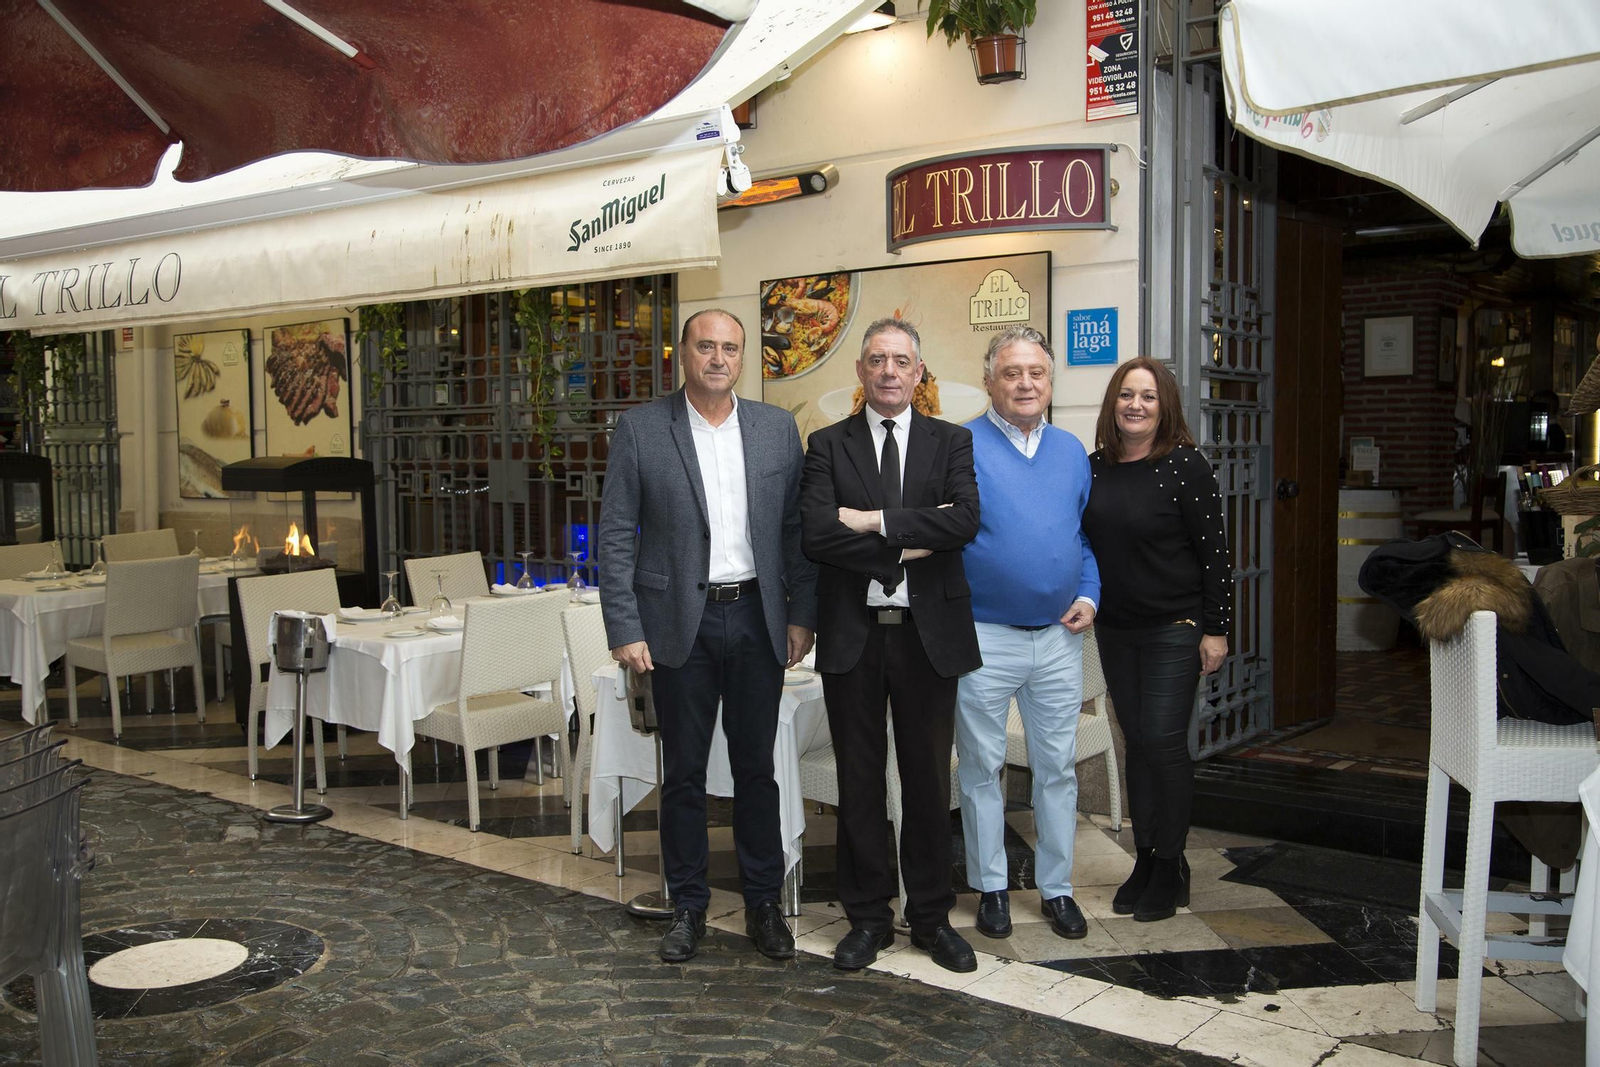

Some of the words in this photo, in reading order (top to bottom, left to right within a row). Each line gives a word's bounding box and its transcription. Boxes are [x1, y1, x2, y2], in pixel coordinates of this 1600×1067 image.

[1092, 14, 1104, 22] 951
[1105, 11, 1114, 19] 45
[1115, 9, 1124, 17] 32
[1103, 64, 1122, 73] ZONA
[1088, 71, 1137, 84] VIDEOVIGILADA
[1089, 87, 1103, 95] 951
[1104, 84, 1114, 93] 45
[1115, 82, 1125, 91] 32
[1126, 80, 1136, 89] 48
[602, 175, 636, 187] CERVEZAS
[892, 179, 916, 239] EL
[925, 158, 1096, 228] TRILLO
[614, 241, 632, 251] 1890
[0, 274, 18, 319] L
[31, 252, 182, 317] TRILLO
[990, 275, 1010, 293] EL
[1072, 313, 1092, 321] sabor
[973, 322, 1028, 333] Restaur
[1072, 322, 1079, 330] a
[1079, 313, 1112, 335] má
[1072, 330, 1112, 353] laga
